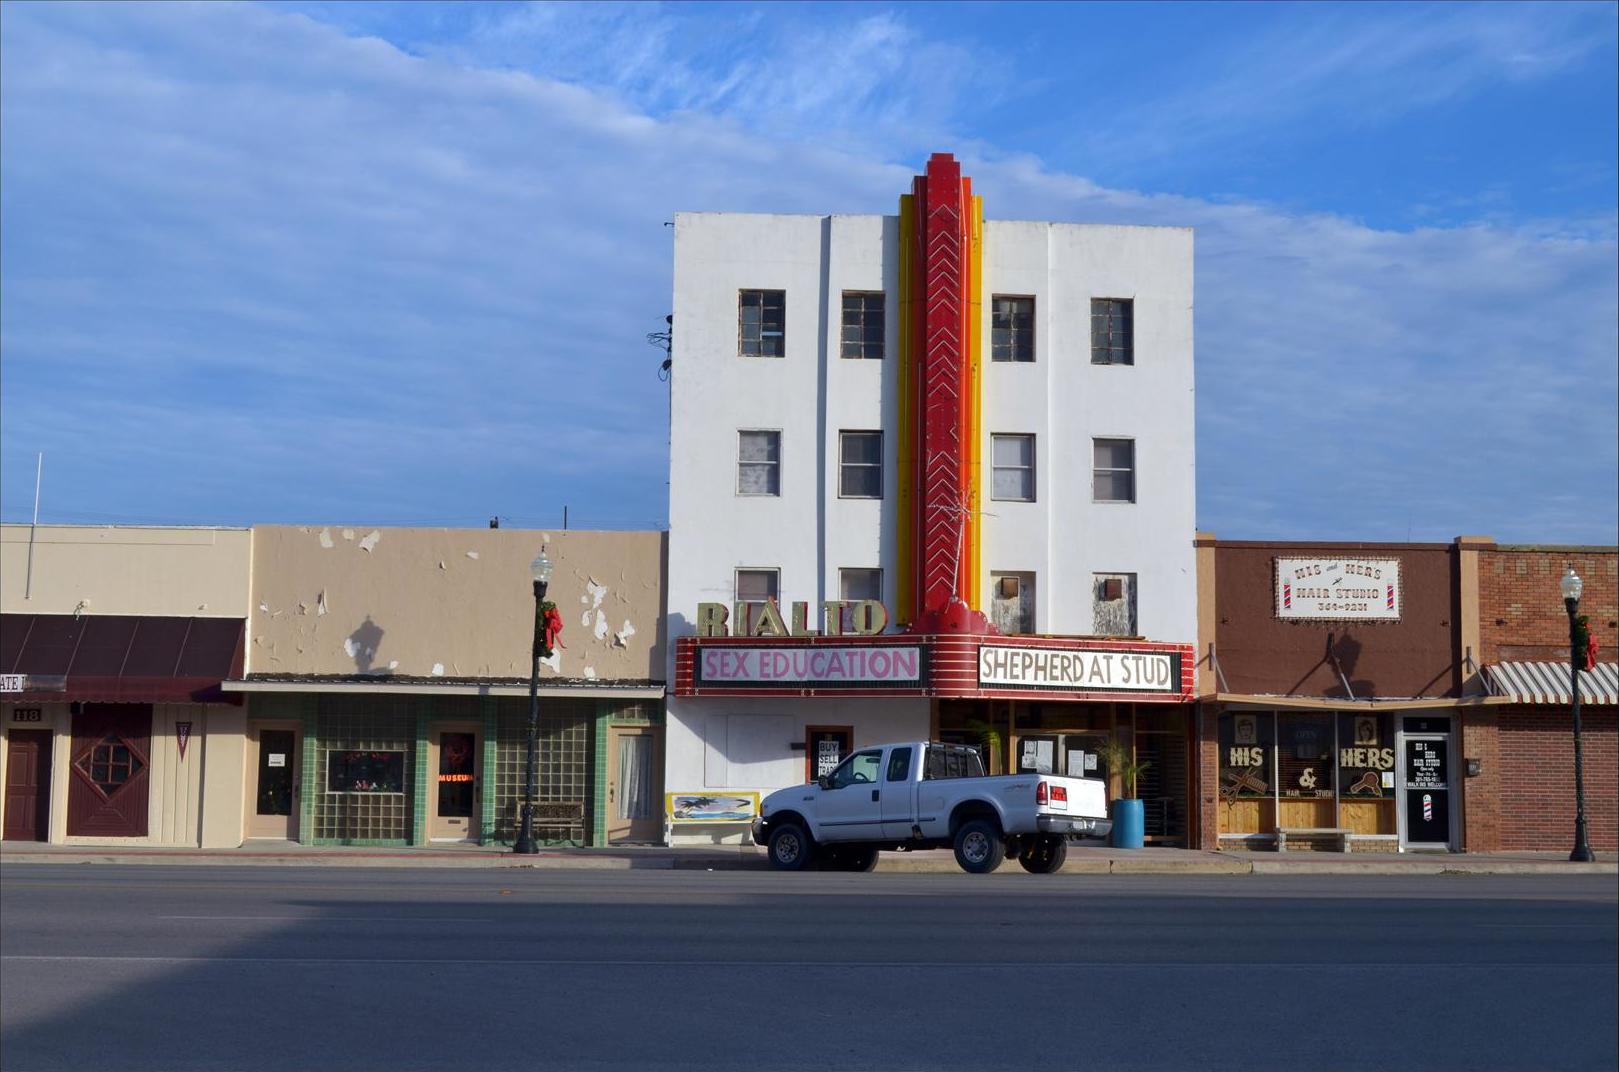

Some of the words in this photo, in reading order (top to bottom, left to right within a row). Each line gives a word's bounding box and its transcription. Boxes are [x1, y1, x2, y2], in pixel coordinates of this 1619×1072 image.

[1294, 564, 1322, 580] HIS
[1296, 587, 1330, 599] HAIR
[1335, 588, 1379, 599] STUDIO
[697, 600, 888, 637] RIALTO
[705, 651, 750, 679] SEX
[759, 650, 917, 680] EDUCATION
[981, 649, 1085, 683] SHEPHERD
[1088, 654, 1114, 684] AT
[1121, 655, 1169, 687] STUD
[15, 710, 40, 721] 118
[819, 742, 838, 752] BUY
[819, 754, 838, 764] SELL
[1230, 747, 1264, 767] HIS
[1340, 748, 1394, 770] HERS
